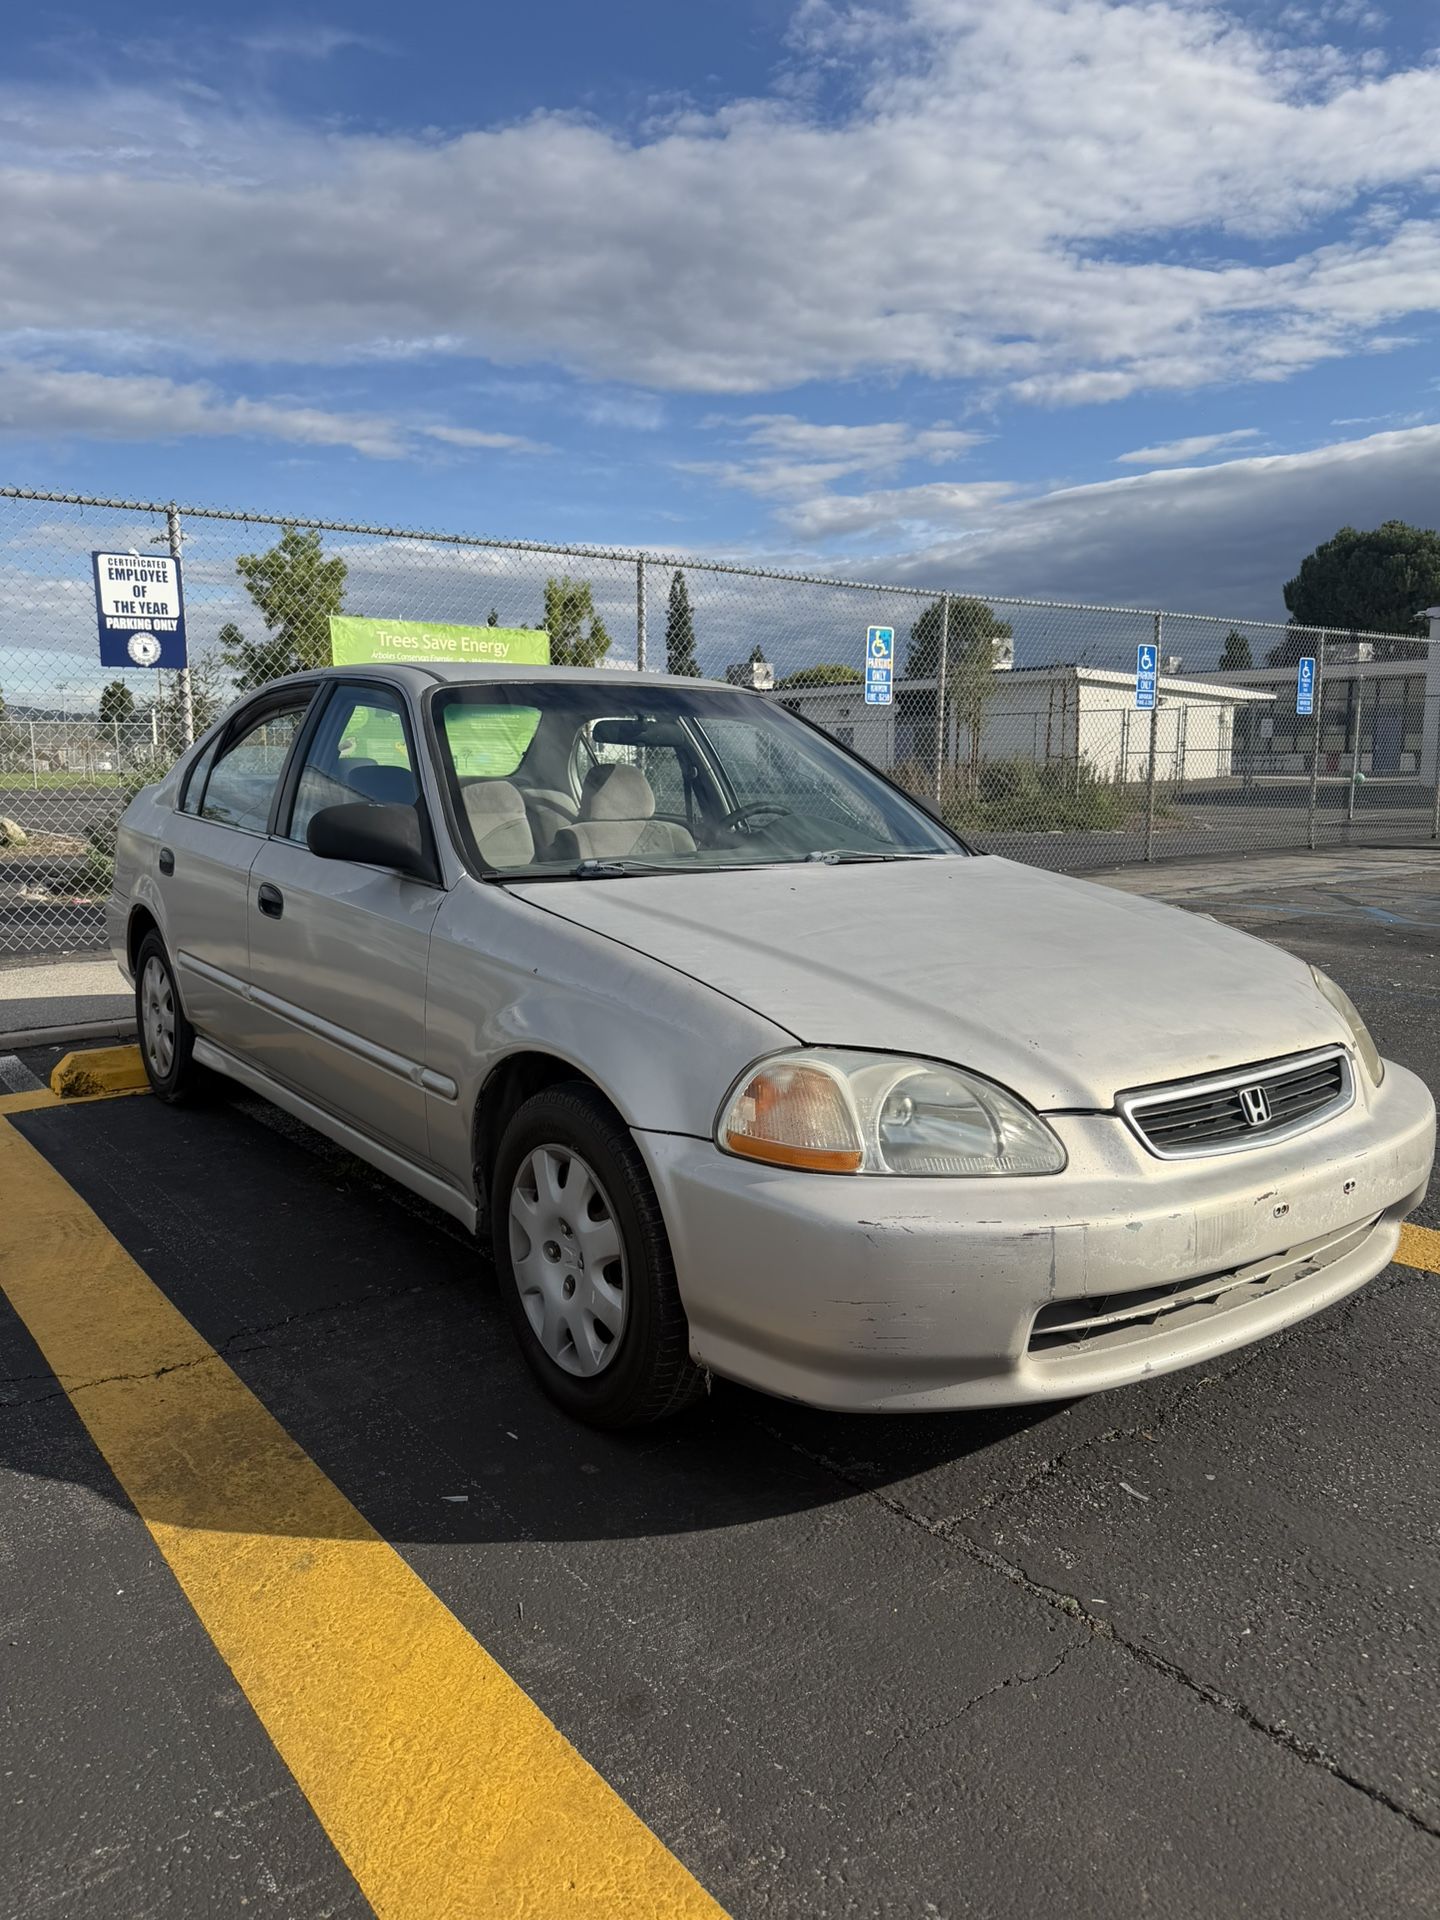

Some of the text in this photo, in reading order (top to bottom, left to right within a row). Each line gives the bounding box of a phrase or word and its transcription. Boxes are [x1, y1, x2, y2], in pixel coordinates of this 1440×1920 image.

[107, 557, 167, 569] CERTIFICATED
[108, 567, 169, 583] EMPLOYEE
[132, 585, 147, 598] OF
[113, 600, 169, 615] THE YEAR
[105, 617, 178, 632] PARKING ONLY
[376, 630, 511, 657] Trees Save Energy
[872, 670, 887, 681] ONLY
